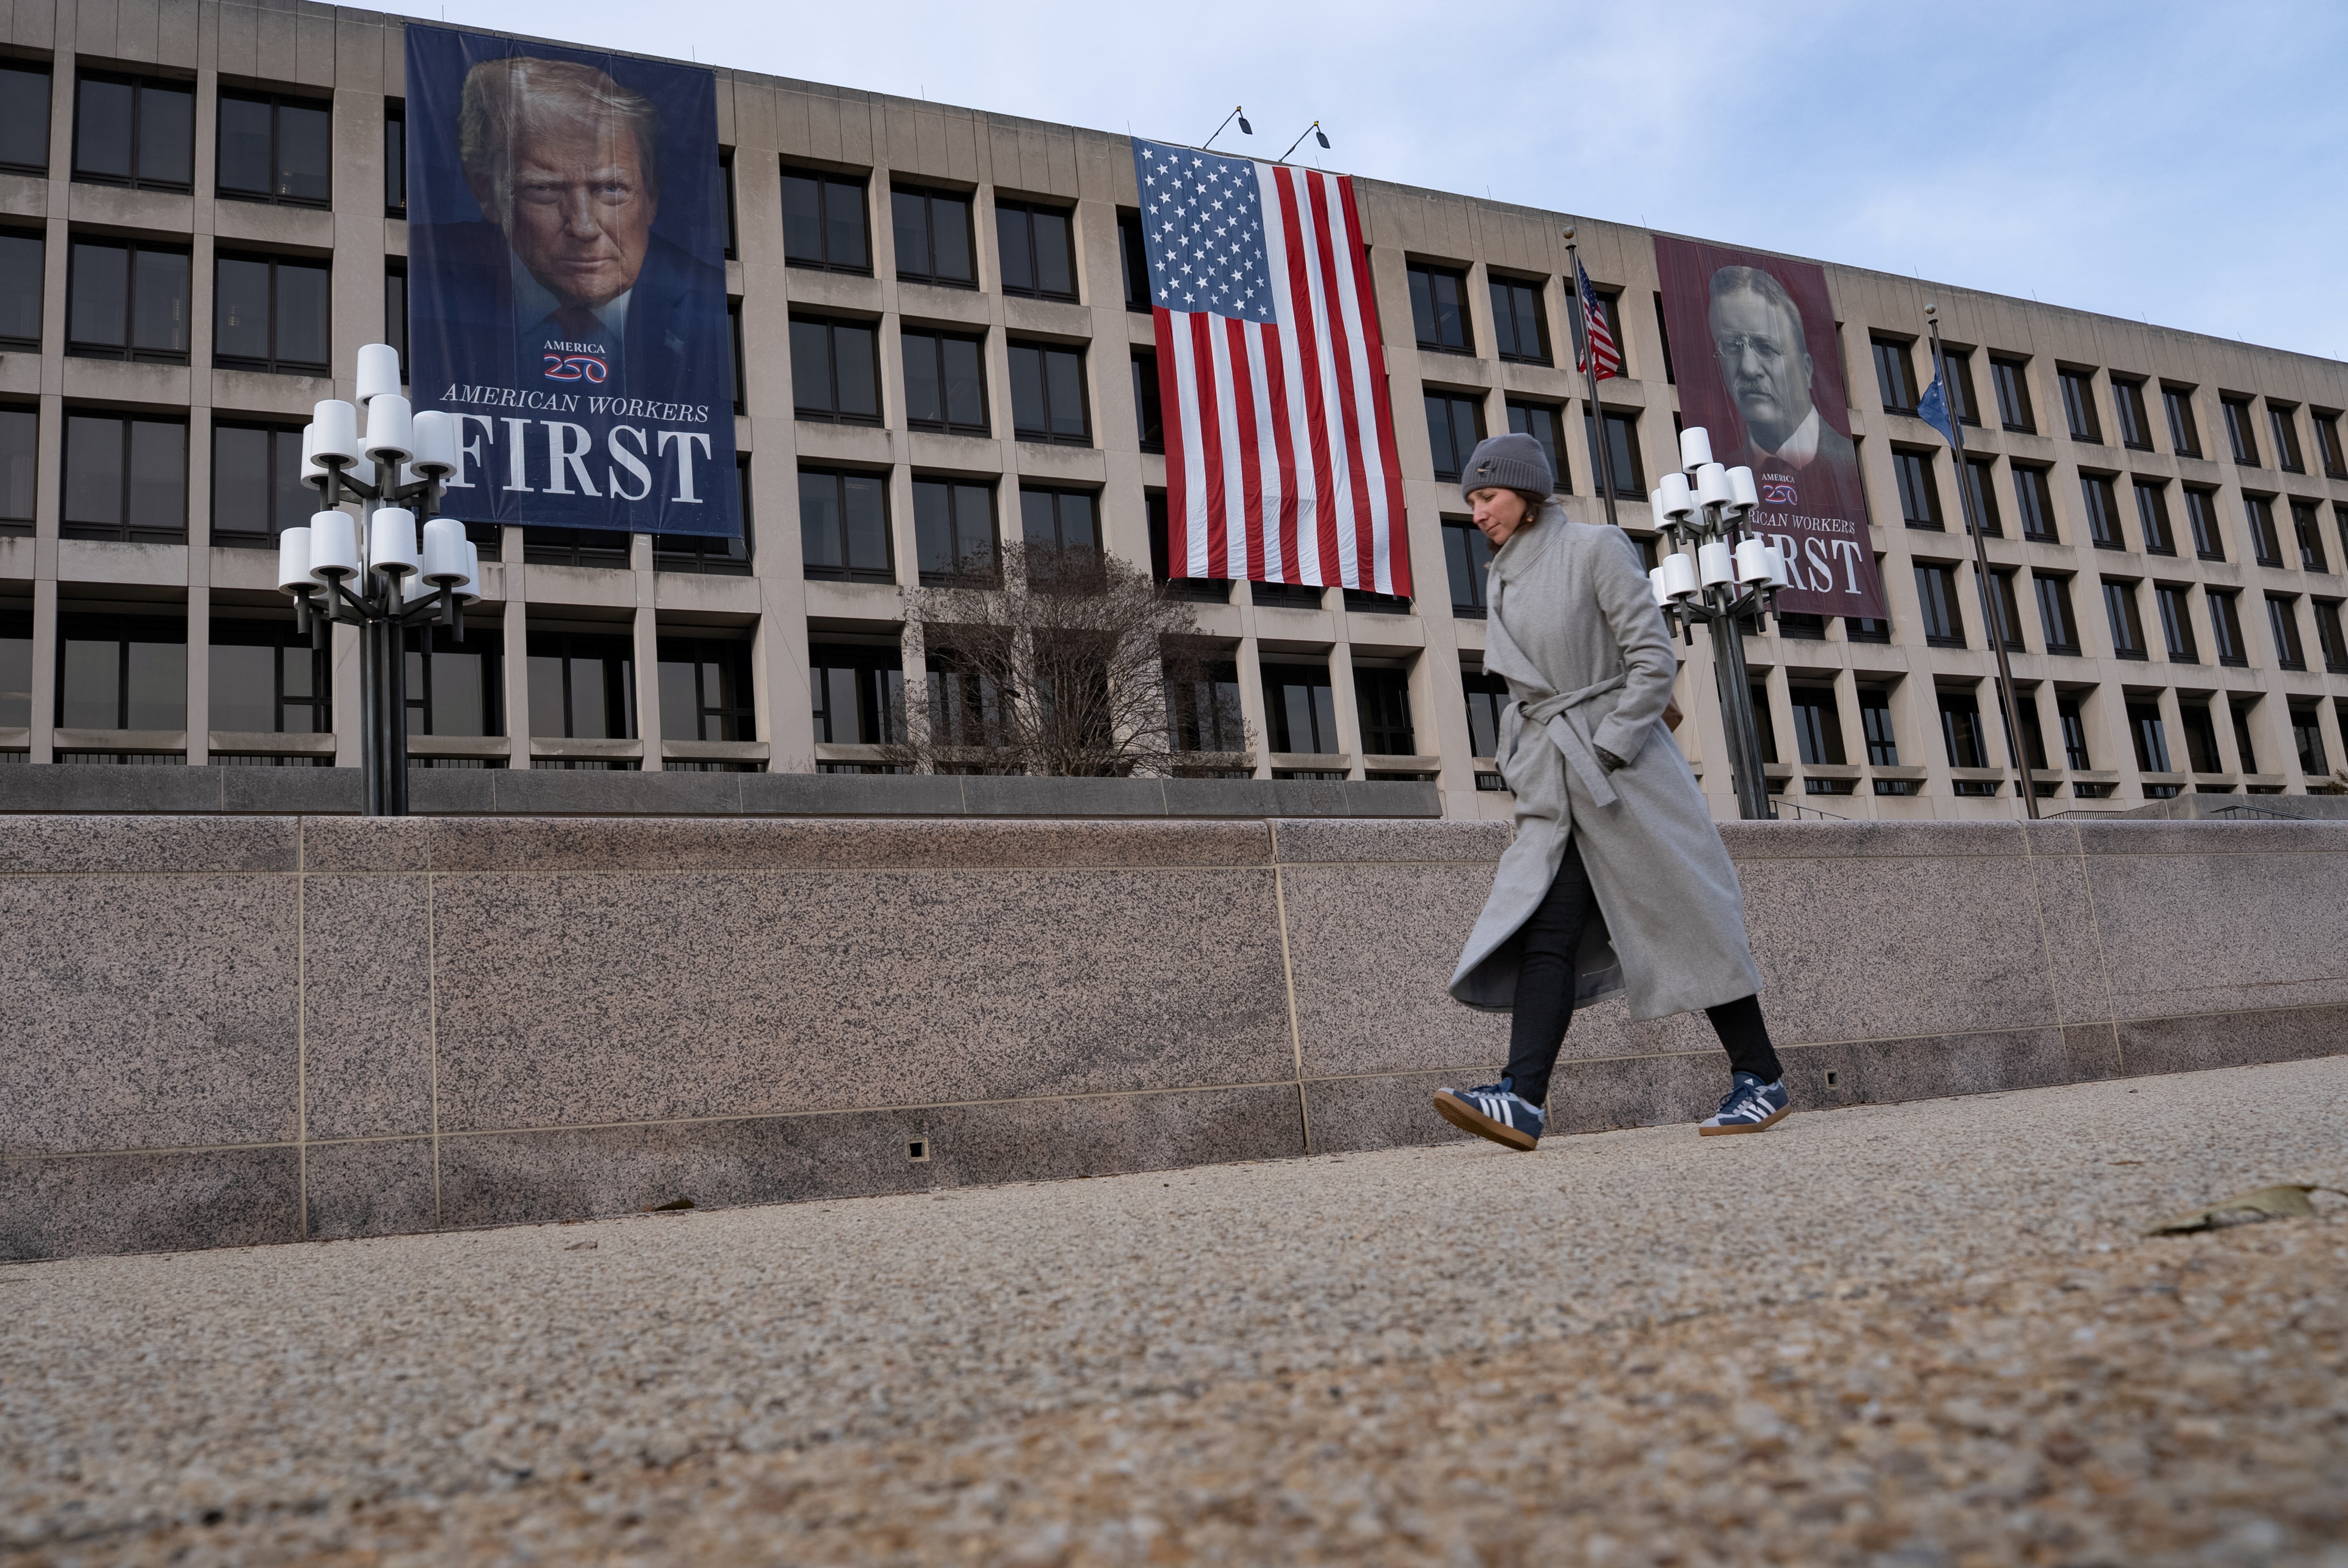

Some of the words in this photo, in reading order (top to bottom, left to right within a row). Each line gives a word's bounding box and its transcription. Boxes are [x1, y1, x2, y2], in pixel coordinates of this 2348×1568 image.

[544, 340, 606, 353] AMERICA
[544, 354, 609, 384] 250
[439, 383, 581, 412] AMERICAN
[588, 396, 709, 423] WORKERS
[446, 413, 711, 503] FIRST
[1762, 473, 1795, 484] AMERICA
[1763, 483, 1799, 505] 250
[1748, 510, 1788, 526] RICAN
[1792, 515, 1855, 534] WORKERS
[1723, 529, 1862, 594] RST
